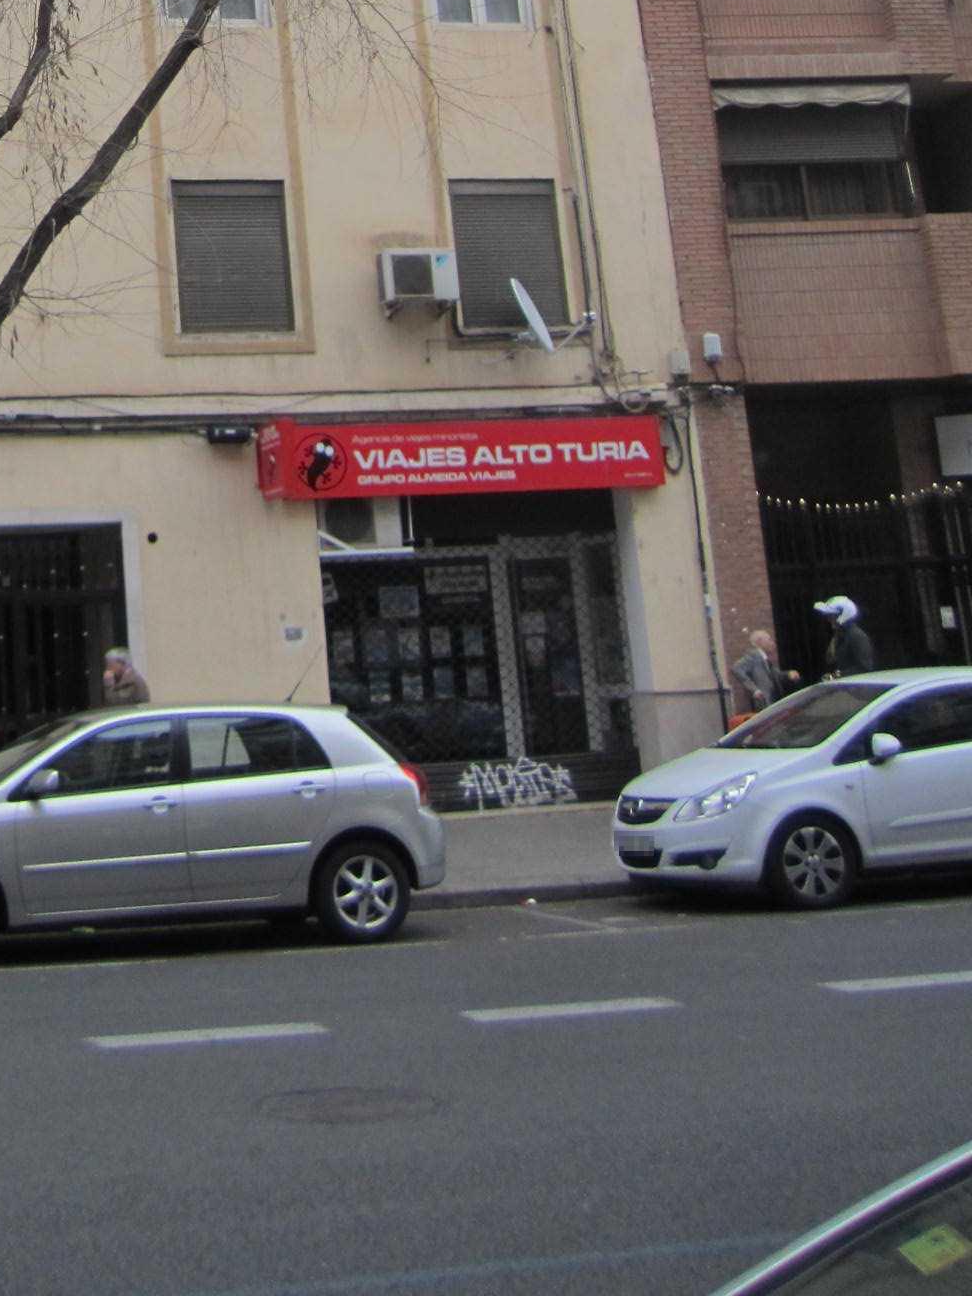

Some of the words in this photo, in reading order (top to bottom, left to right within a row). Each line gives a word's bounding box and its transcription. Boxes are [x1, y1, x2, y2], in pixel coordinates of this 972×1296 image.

[353, 446, 468, 470] VIAJES
[472, 444, 554, 466] ALTO
[556, 440, 650, 463] TURIA
[357, 473, 406, 486] GRUPO
[407, 471, 468, 484] ALMEIDA
[469, 470, 517, 481] VIAJES
